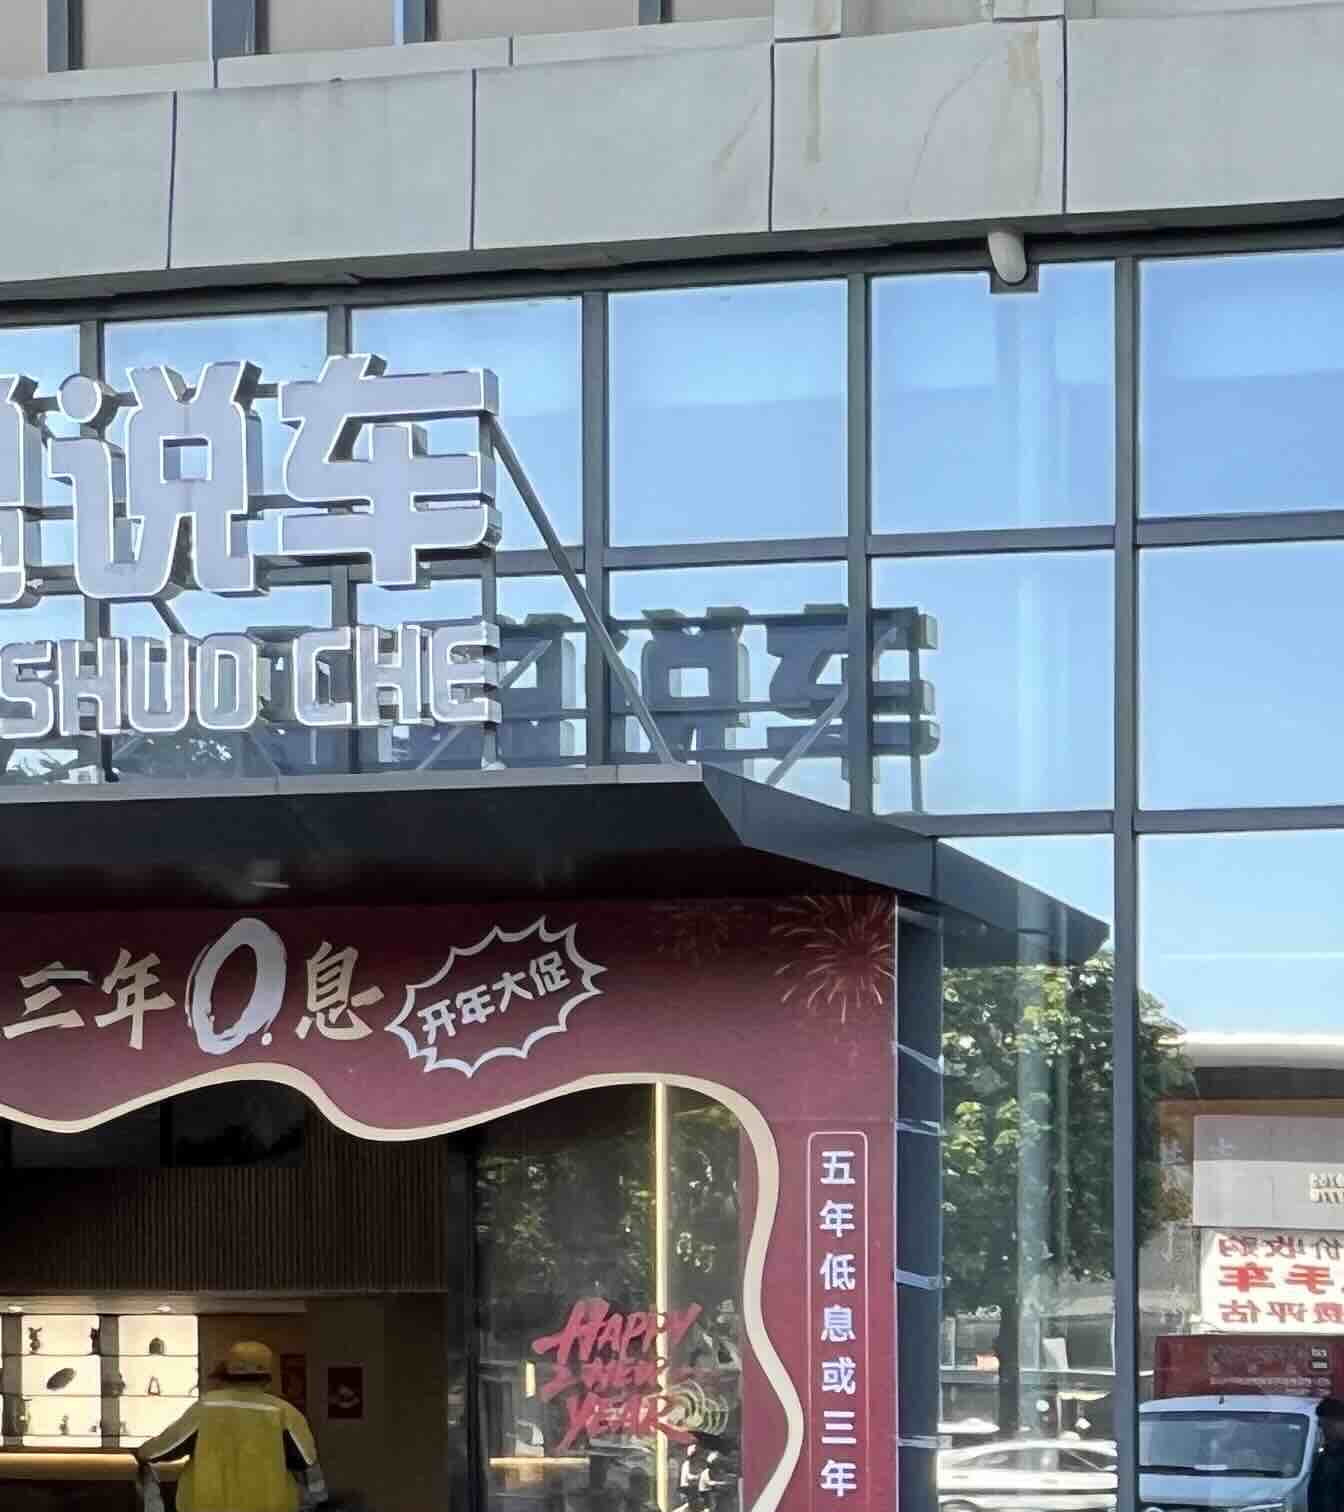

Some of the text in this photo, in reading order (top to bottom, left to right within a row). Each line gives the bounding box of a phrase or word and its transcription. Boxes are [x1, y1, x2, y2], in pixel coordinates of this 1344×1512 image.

[0, 354, 502, 608] 说车
[0, 622, 501, 741] SHUO CHE
[416, 950, 571, 1045] 开年大促
[531, 1296, 703, 1366] HAPPY
